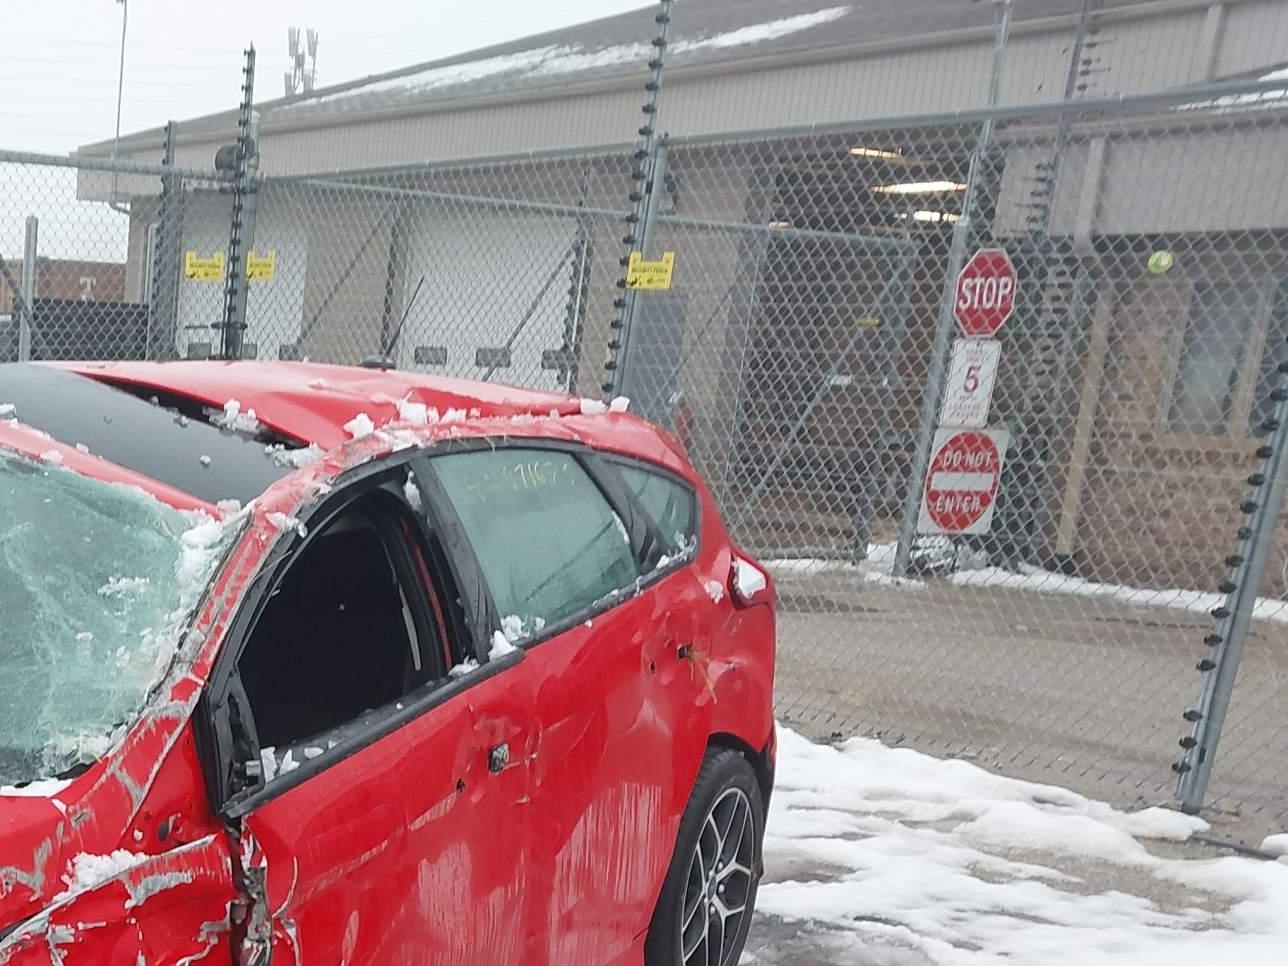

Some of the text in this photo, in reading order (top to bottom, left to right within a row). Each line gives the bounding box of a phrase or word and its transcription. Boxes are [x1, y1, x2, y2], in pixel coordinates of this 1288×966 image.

[958, 277, 1013, 310] STOP
[963, 365, 980, 393] 5
[943, 450, 993, 468] DO NOT
[935, 495, 981, 513] ENTER
